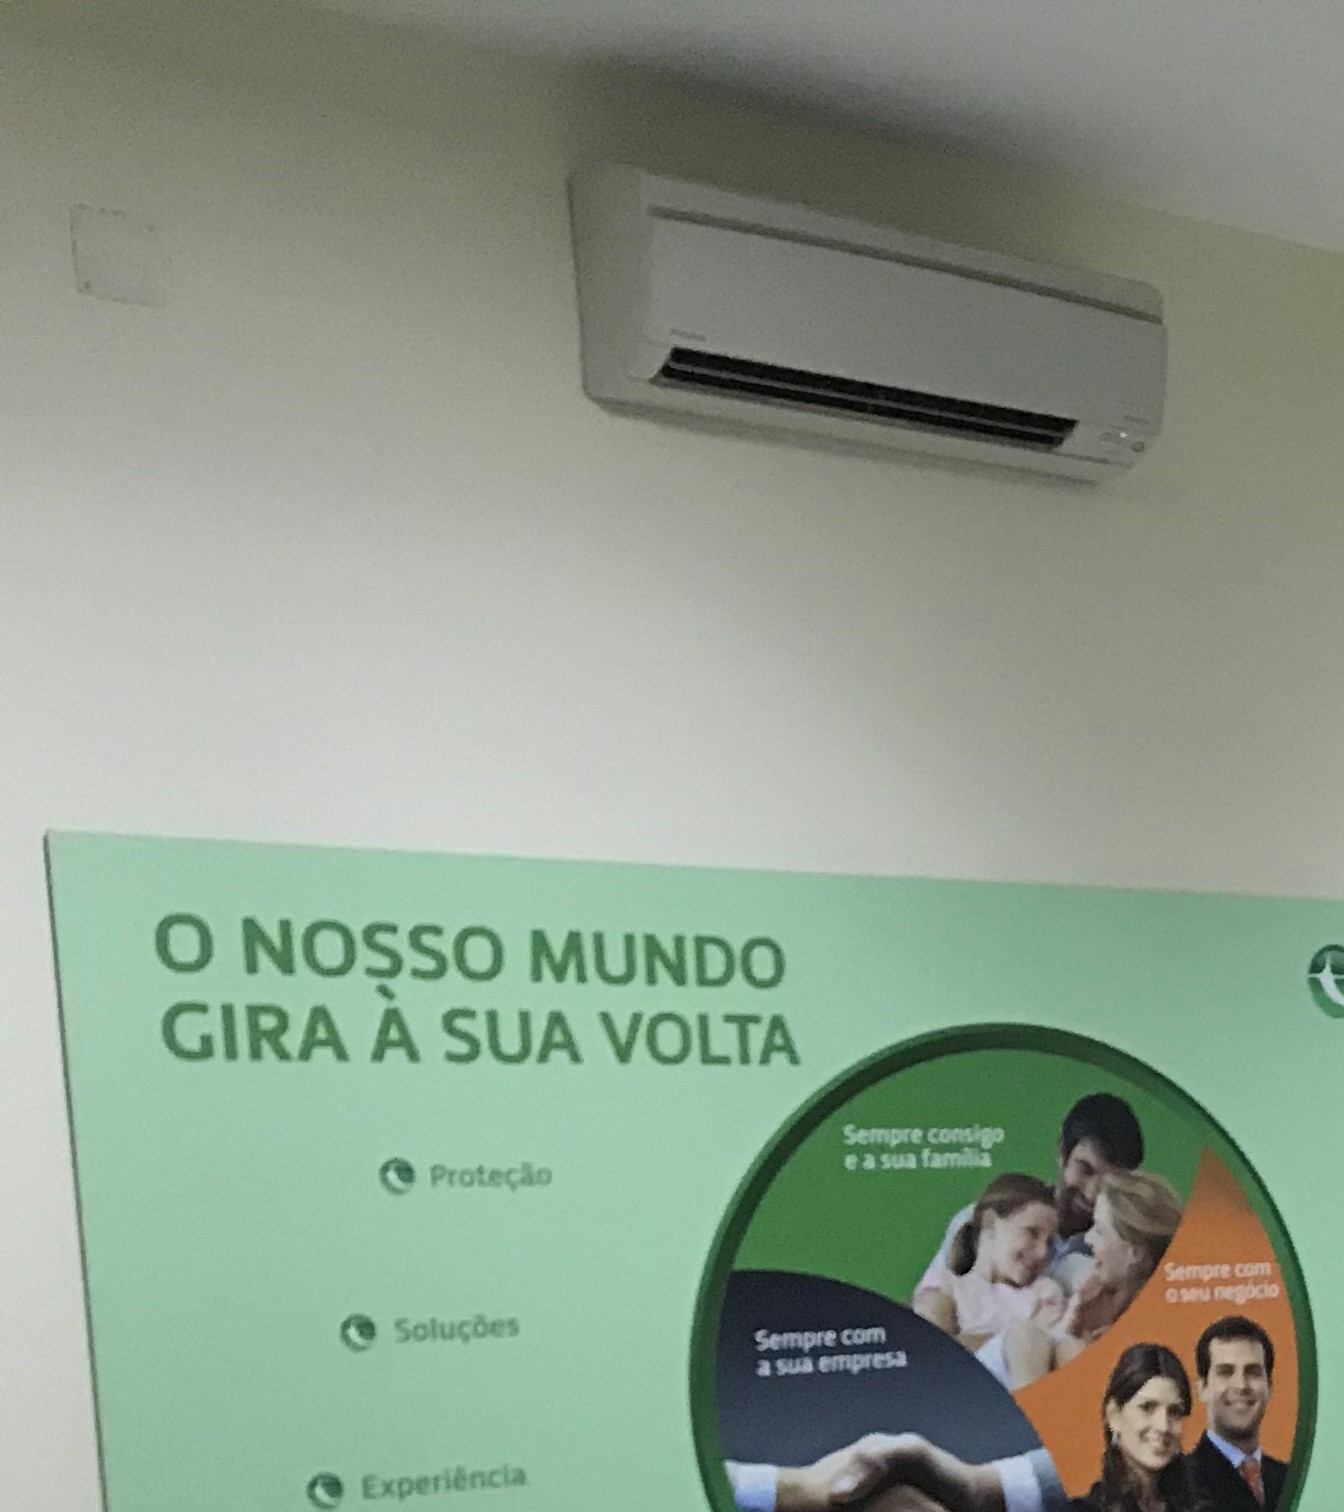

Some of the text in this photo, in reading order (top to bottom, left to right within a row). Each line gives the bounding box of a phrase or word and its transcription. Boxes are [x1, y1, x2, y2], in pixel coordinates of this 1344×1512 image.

[155, 913, 787, 990] O NOSSO MUNDO
[160, 982, 801, 1067] GIRA À SUA VOLTA
[842, 1124, 1006, 1149] Sempre consigo
[843, 1154, 857, 1170] e
[862, 1154, 876, 1169] a
[880, 1152, 917, 1169] sua
[429, 1162, 553, 1193] Proteção
[1163, 1261, 1273, 1282] Sempre com
[1165, 1287, 1178, 1303] o
[1179, 1287, 1212, 1303] seu
[394, 1312, 521, 1345] Soluções
[754, 1326, 887, 1353] Sempre com
[756, 1350, 908, 1377] a sua empresa
[361, 1463, 528, 1502] Experiência
